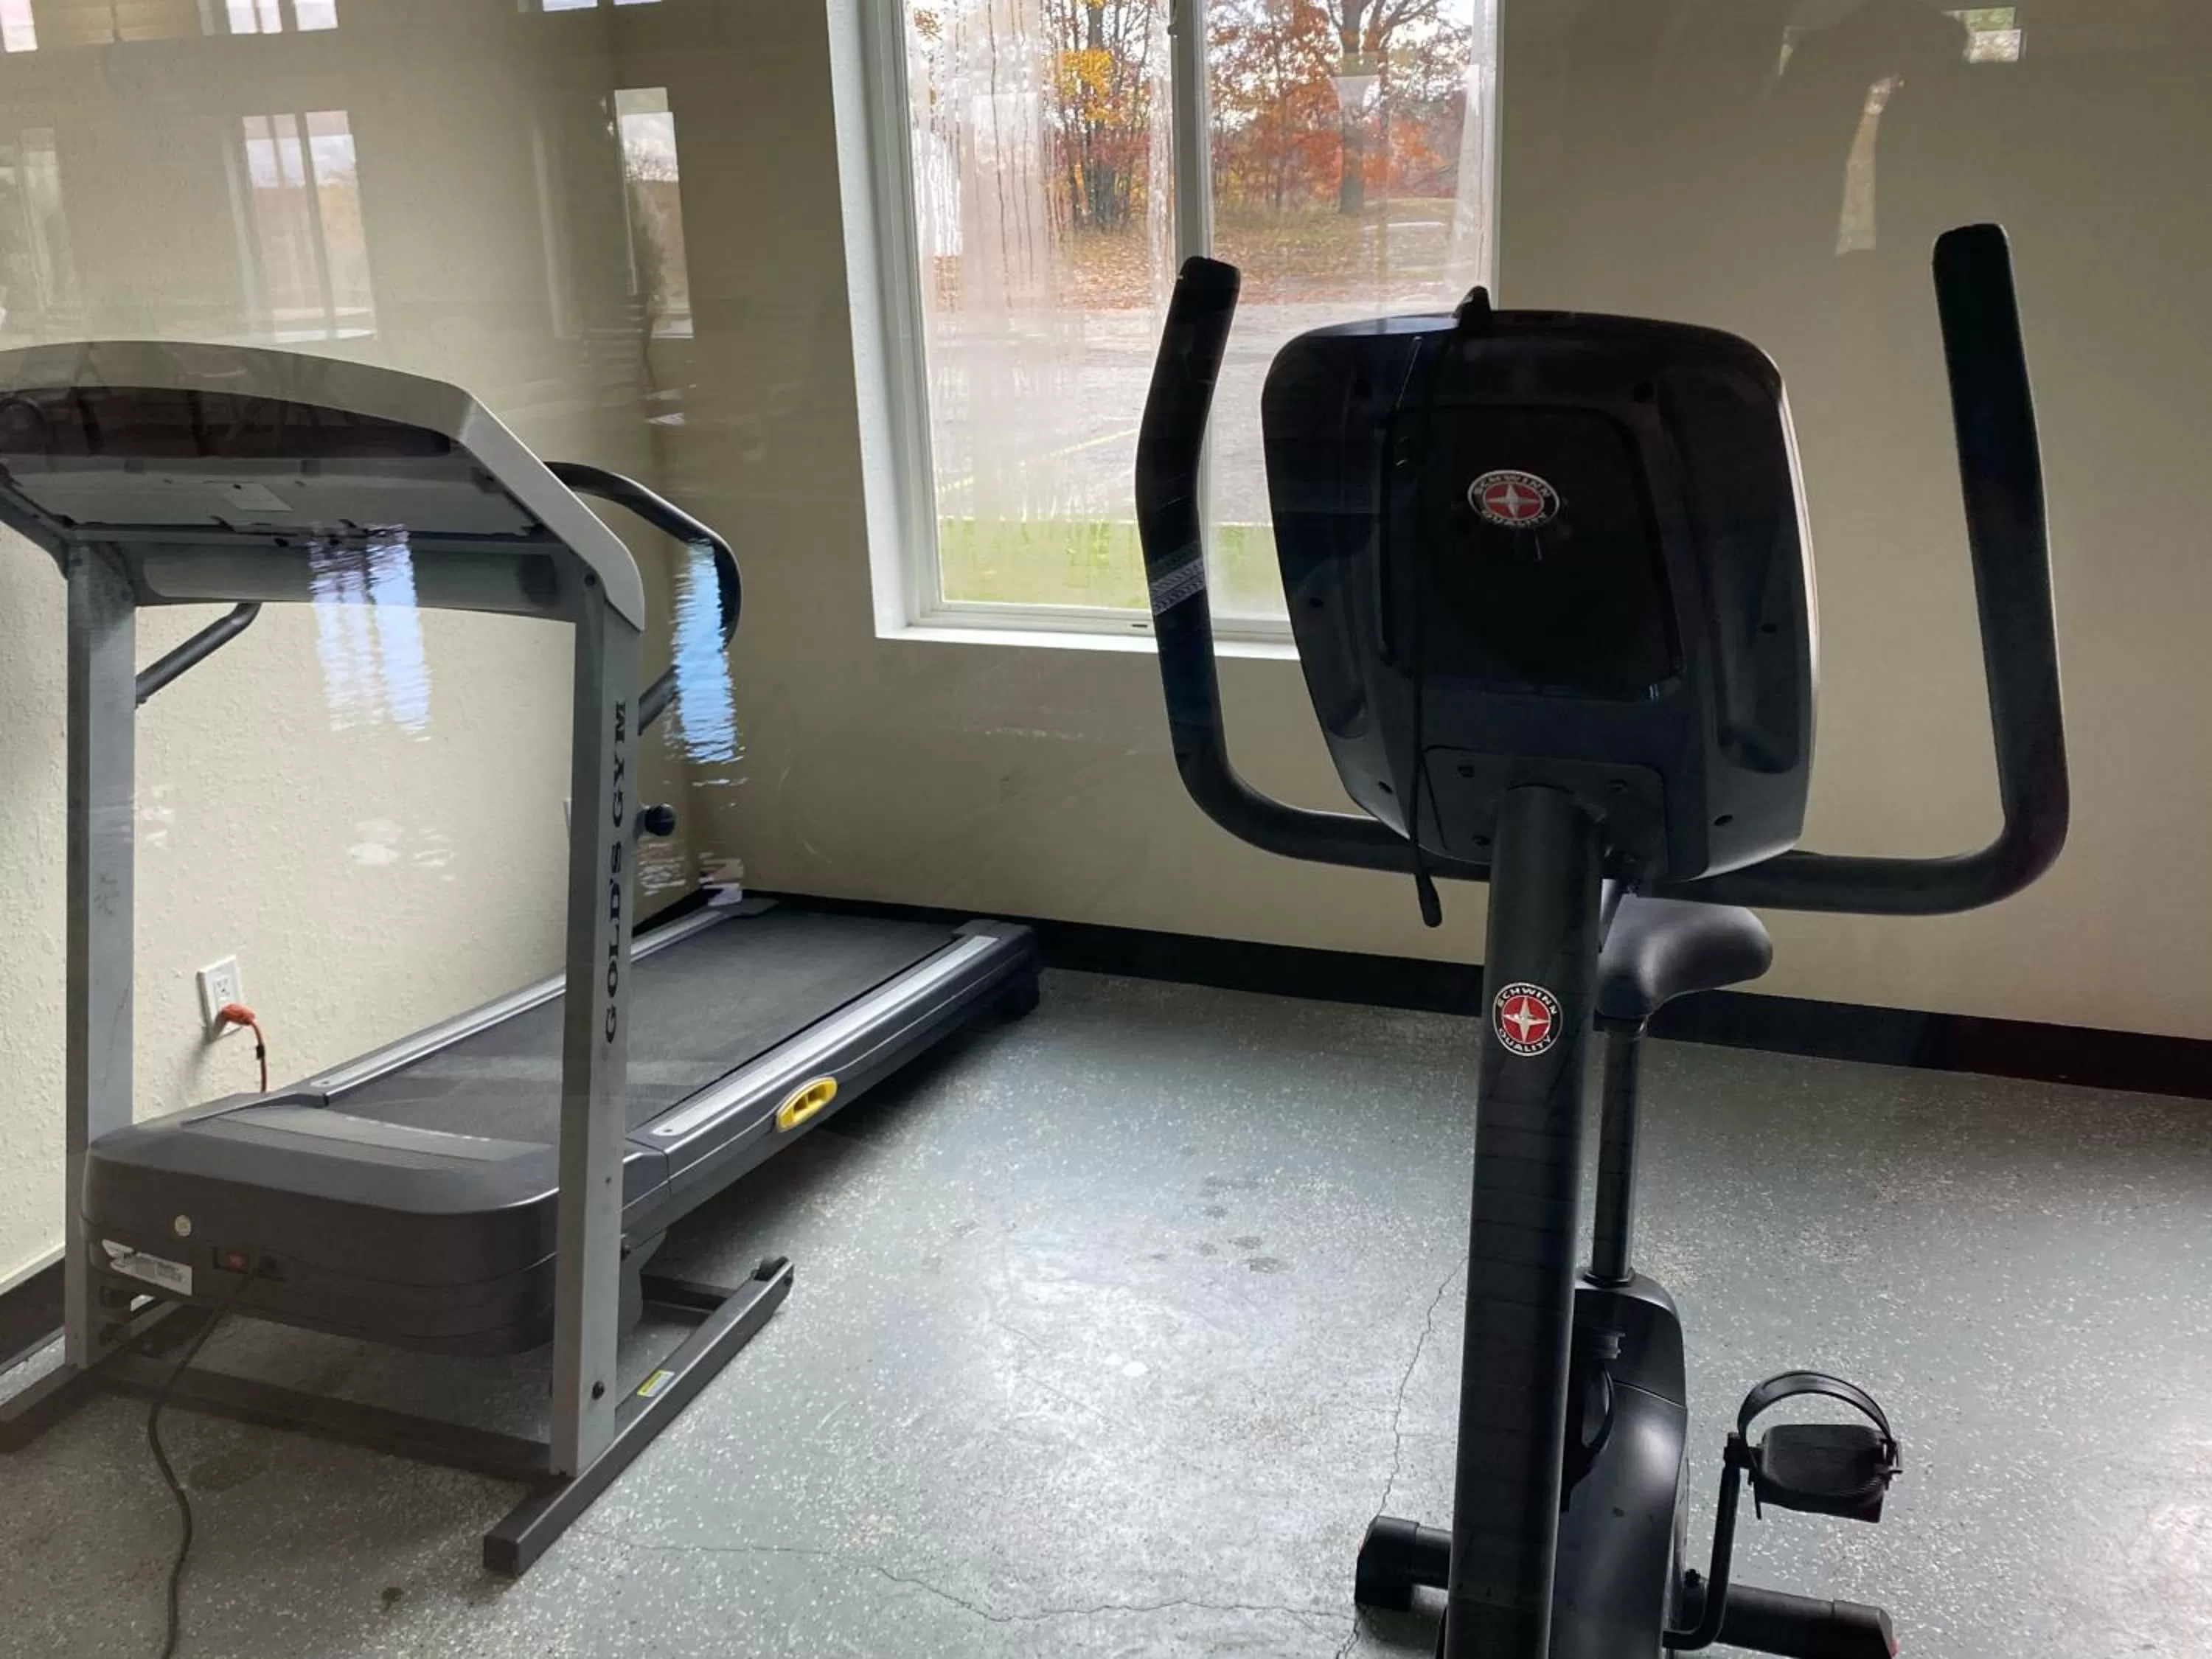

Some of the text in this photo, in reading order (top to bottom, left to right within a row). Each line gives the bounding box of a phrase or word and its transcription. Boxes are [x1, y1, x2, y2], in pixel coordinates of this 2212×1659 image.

[1472, 474, 1551, 497] SCHWINN
[605, 700, 627, 1044] GOLD'S GYM
[1497, 987, 1558, 1015] SCHWINN
[1498, 1027, 1551, 1052] QUALITY
